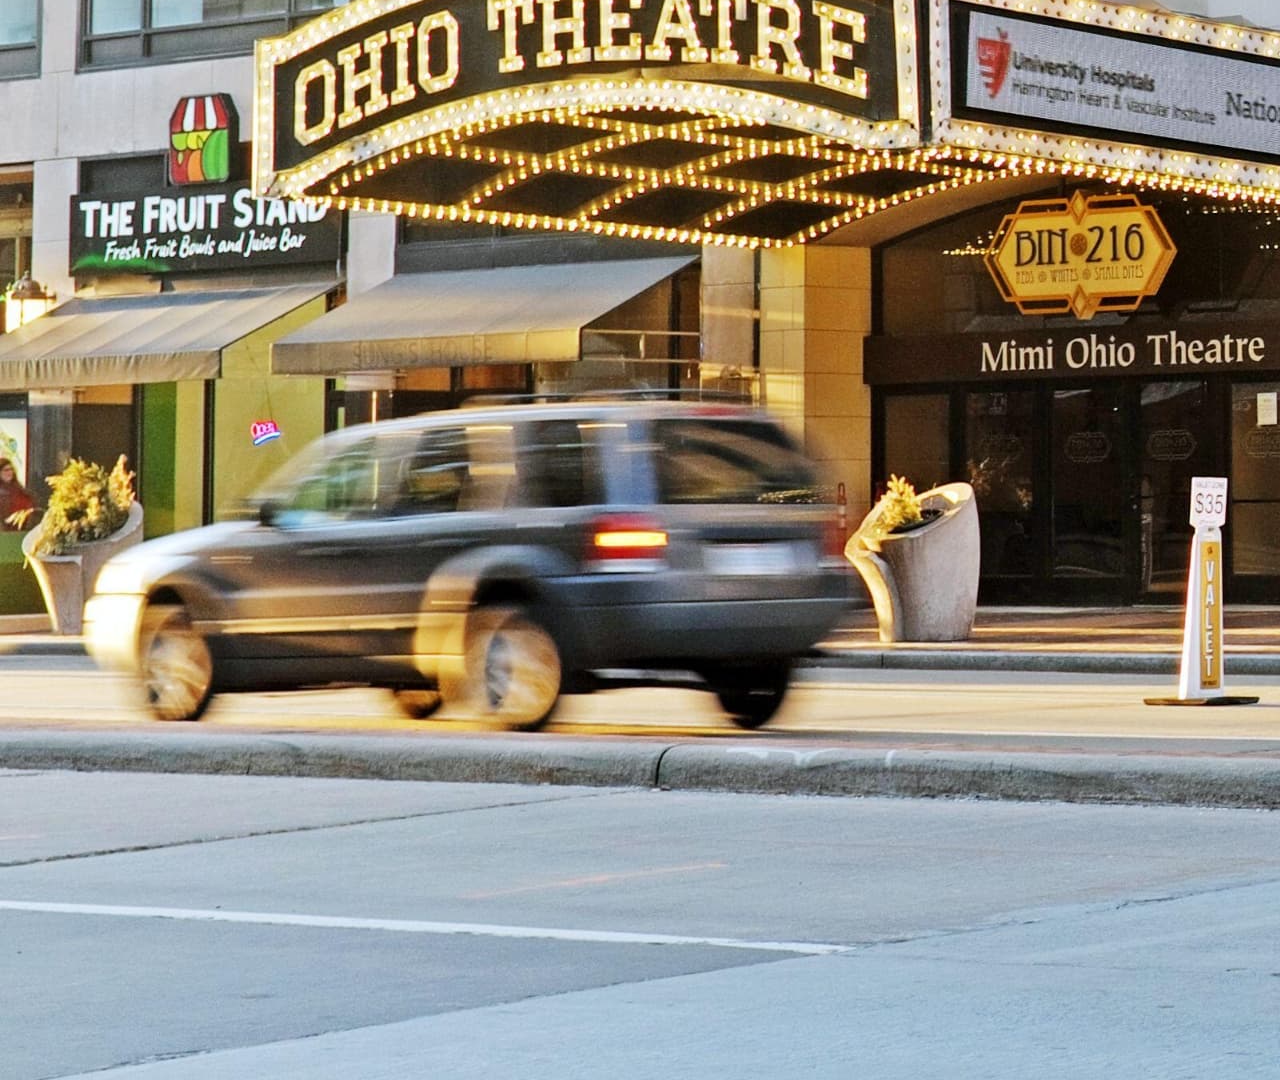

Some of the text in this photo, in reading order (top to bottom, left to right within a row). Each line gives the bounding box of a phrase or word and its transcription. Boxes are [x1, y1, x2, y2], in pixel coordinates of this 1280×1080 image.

[293, 10, 459, 146] OHIO
[1012, 51, 1155, 93] University Hospitals
[80, 188, 332, 238] THE FRUIT STAND
[104, 227, 305, 262] Fresh Fruit Bowls and Juice Bar
[1014, 223, 1145, 267] BIN 216
[1050, 268, 1078, 282] WHITES
[1094, 266, 1120, 280] SMALL
[1122, 264, 1144, 279] BITES
[980, 330, 1265, 372] Mimi Ohio Theatre
[1195, 493, 1223, 514] $35
[1204, 559, 1216, 677] VALET
